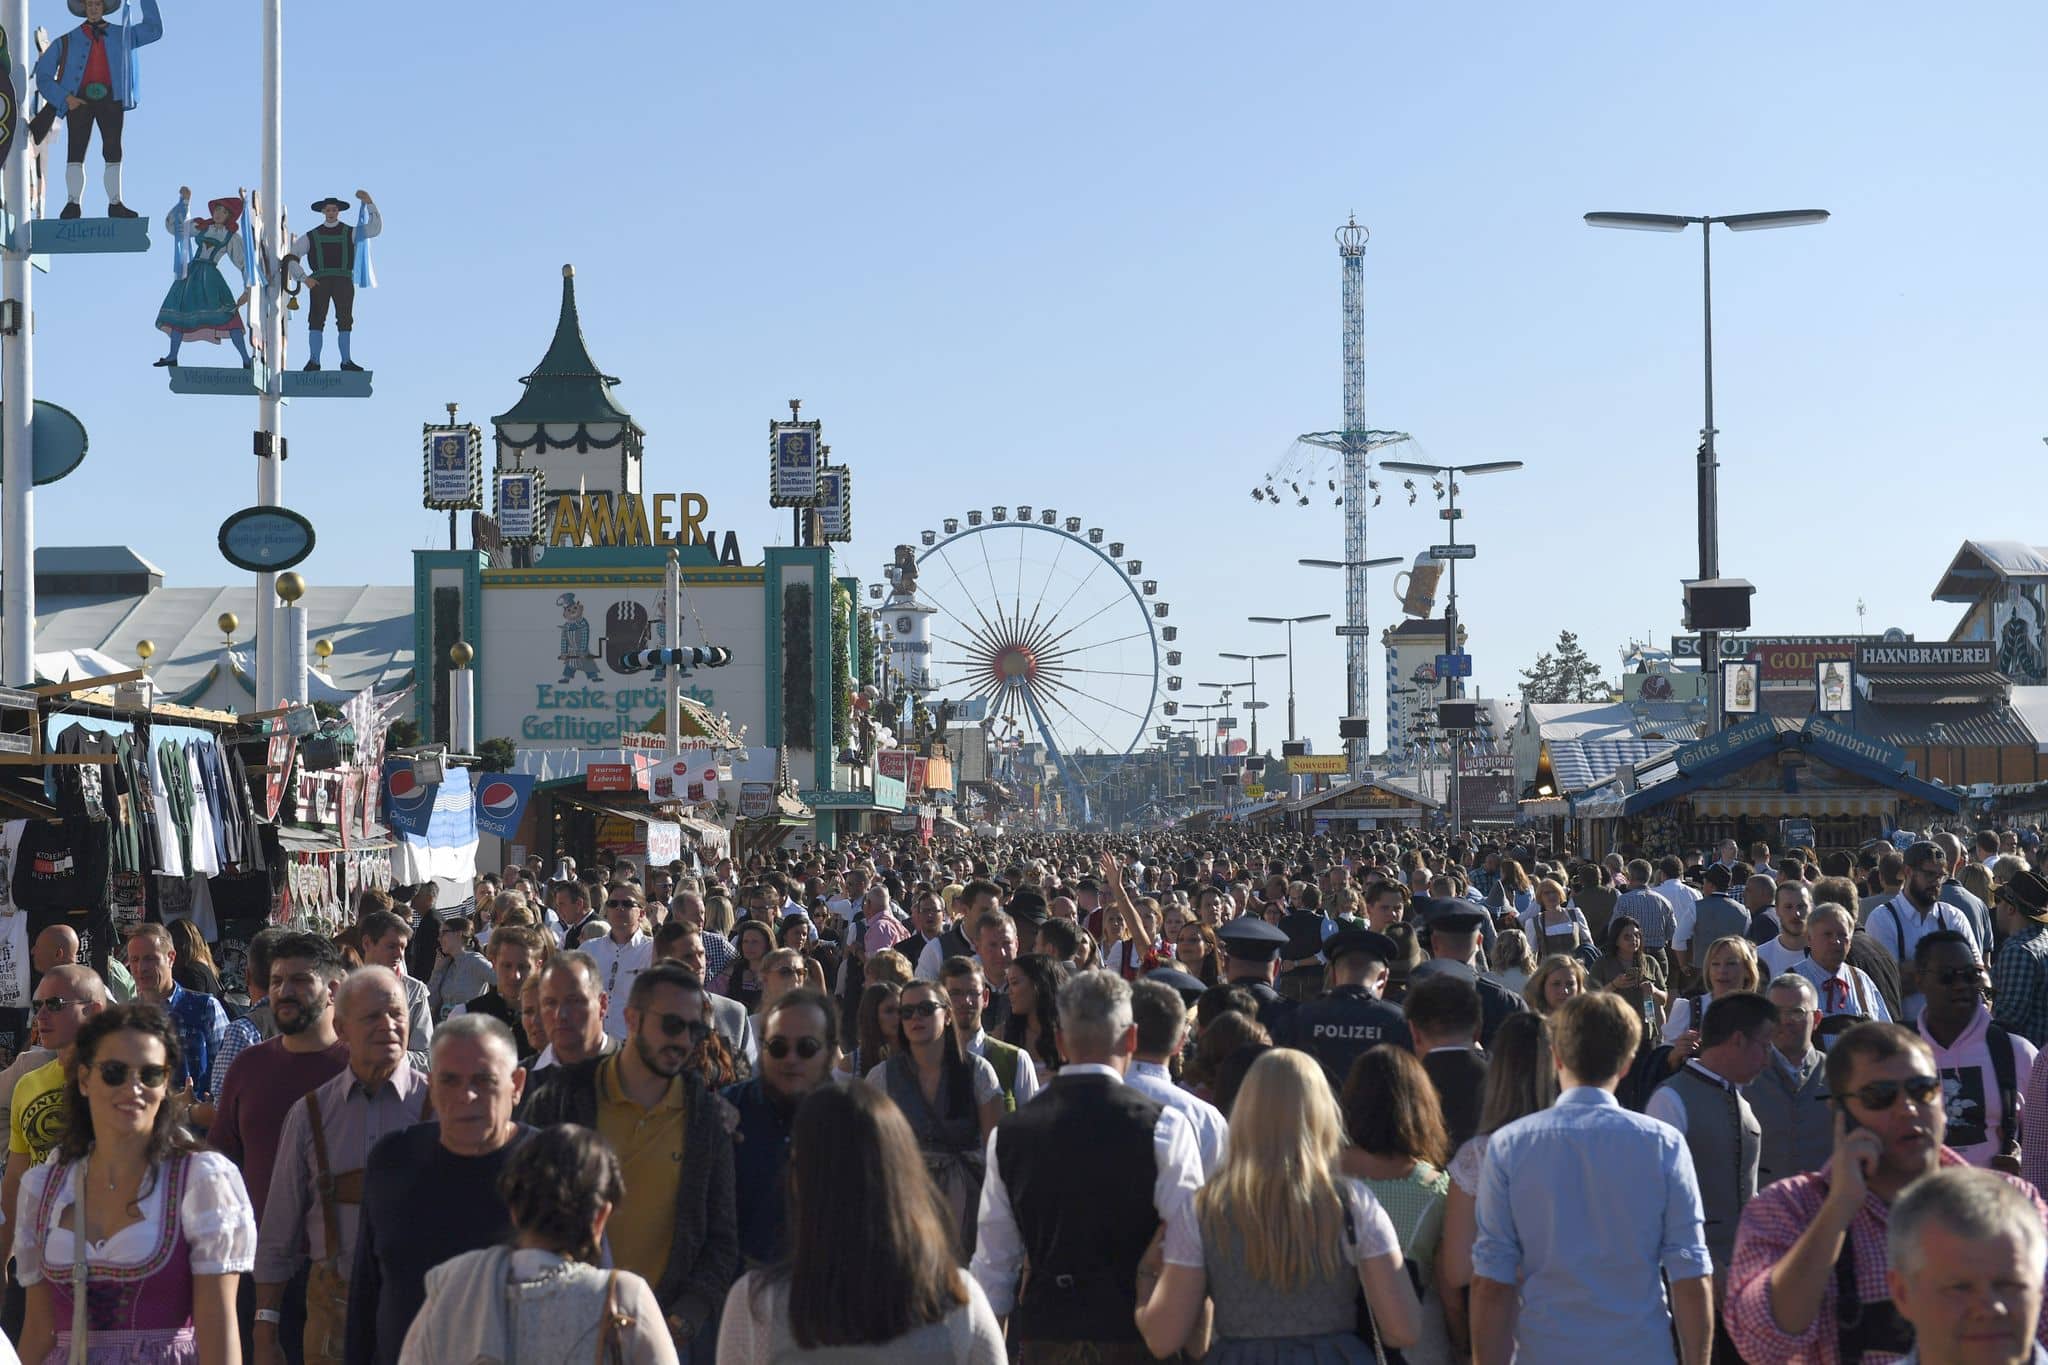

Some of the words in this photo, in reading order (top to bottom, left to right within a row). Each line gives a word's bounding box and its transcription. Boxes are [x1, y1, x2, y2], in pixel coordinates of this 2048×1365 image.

[551, 493, 709, 546] AMMER
[1862, 647, 1990, 664] HAXNBRATEREI
[616, 683, 714, 714] gröste
[641, 735, 666, 749] klein
[1728, 722, 1770, 746] Stein
[1807, 719, 1892, 764] Souvenir
[477, 817, 506, 833] pepsi
[1313, 1024, 1383, 1040] POLIZEI
